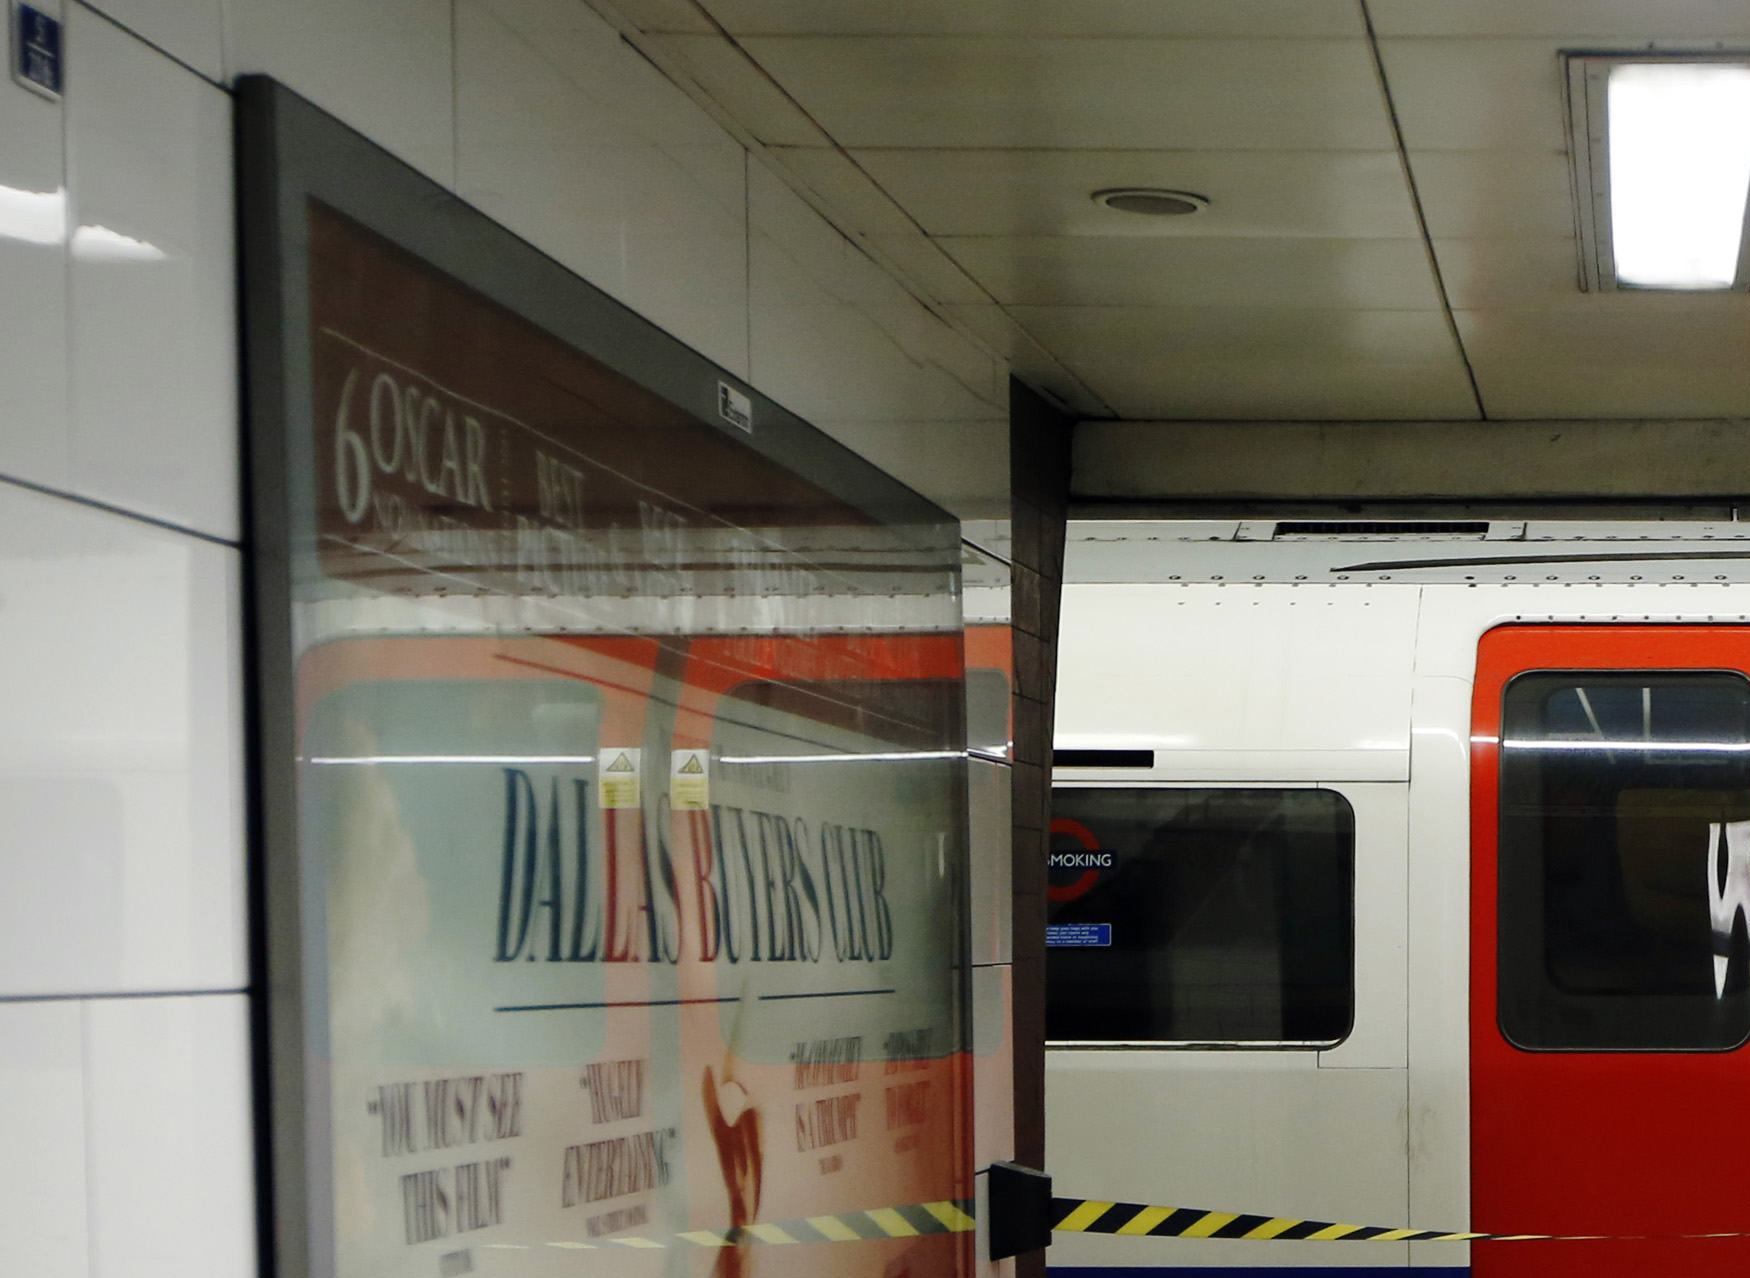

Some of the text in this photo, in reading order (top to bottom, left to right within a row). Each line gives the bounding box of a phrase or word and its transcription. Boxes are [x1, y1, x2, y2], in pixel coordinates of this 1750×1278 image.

[336, 366, 370, 524] 6
[370, 373, 492, 513] OSCAR
[493, 766, 894, 964] DALLAS BUYERS CLUB
[1047, 853, 1112, 867] MOKING
[423, 1076, 486, 1150] MUST
[484, 1072, 524, 1143] SEE
[399, 1168, 449, 1246] THIS
